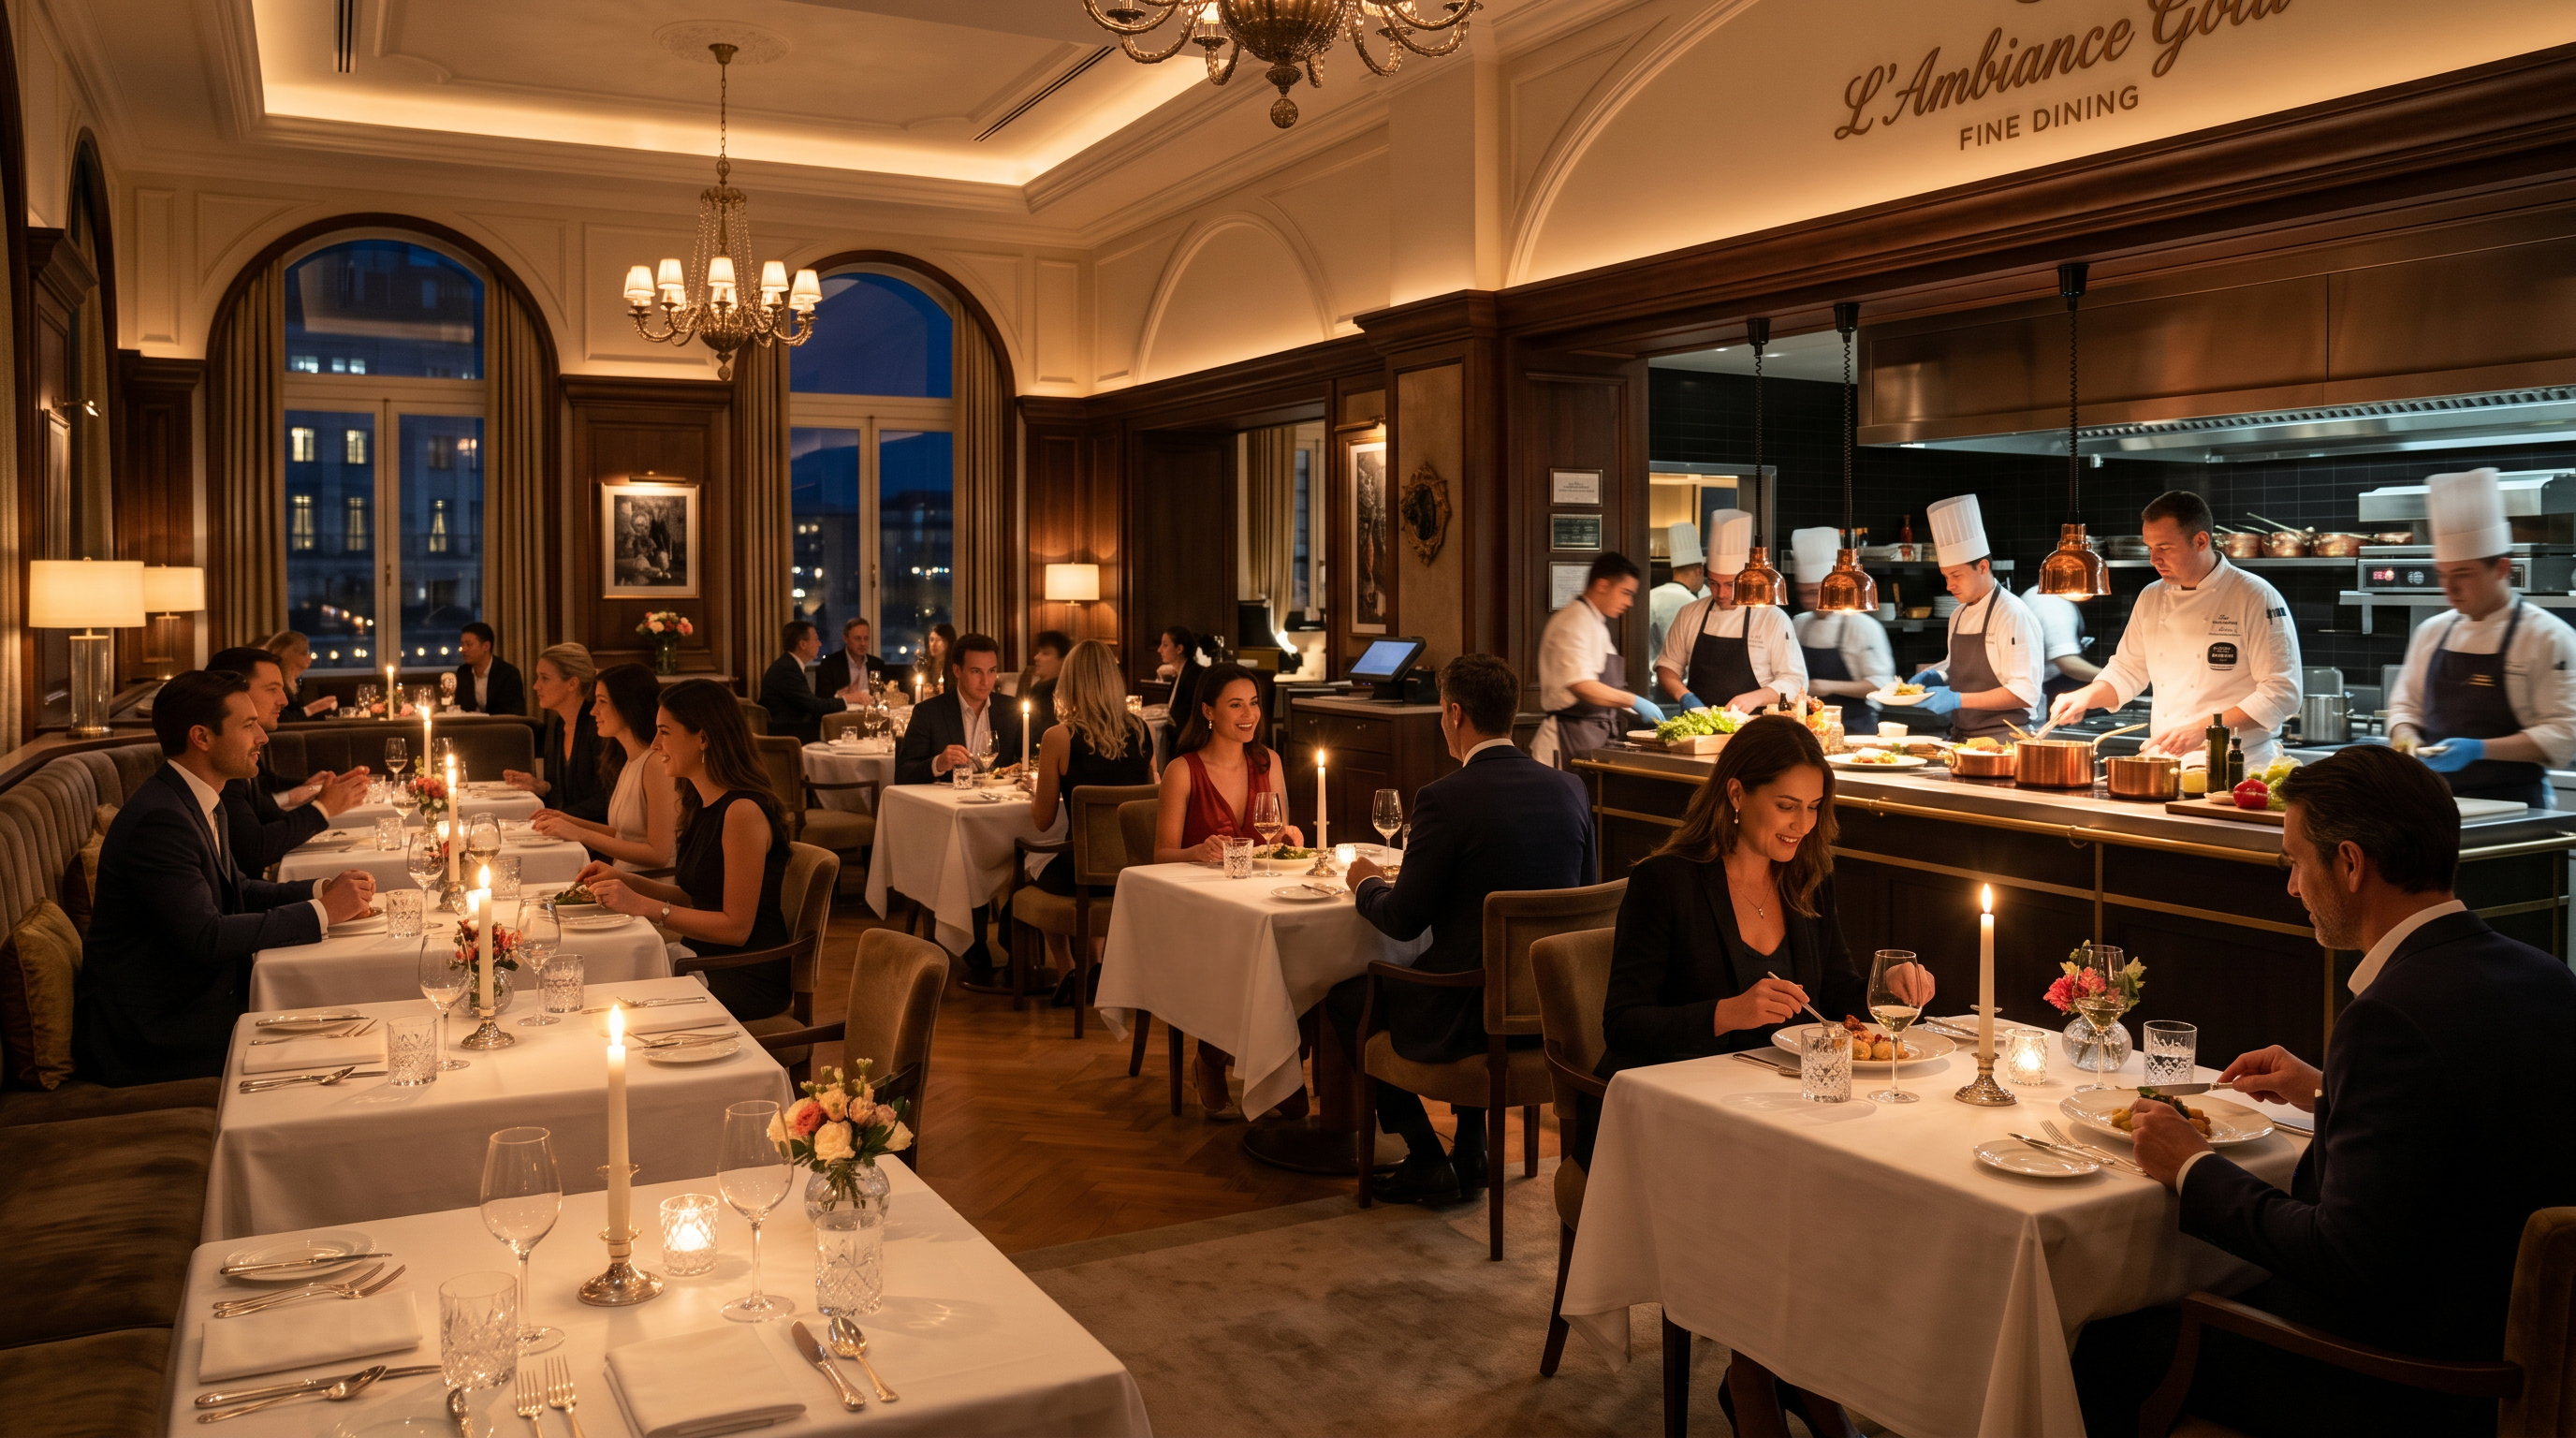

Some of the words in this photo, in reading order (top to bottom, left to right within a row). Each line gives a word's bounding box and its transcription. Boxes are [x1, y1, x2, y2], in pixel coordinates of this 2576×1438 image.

[1834, 18, 2136, 140] L'Ambiance
[1960, 114, 2021, 151] FINE
[2033, 85, 2139, 133] DINING
